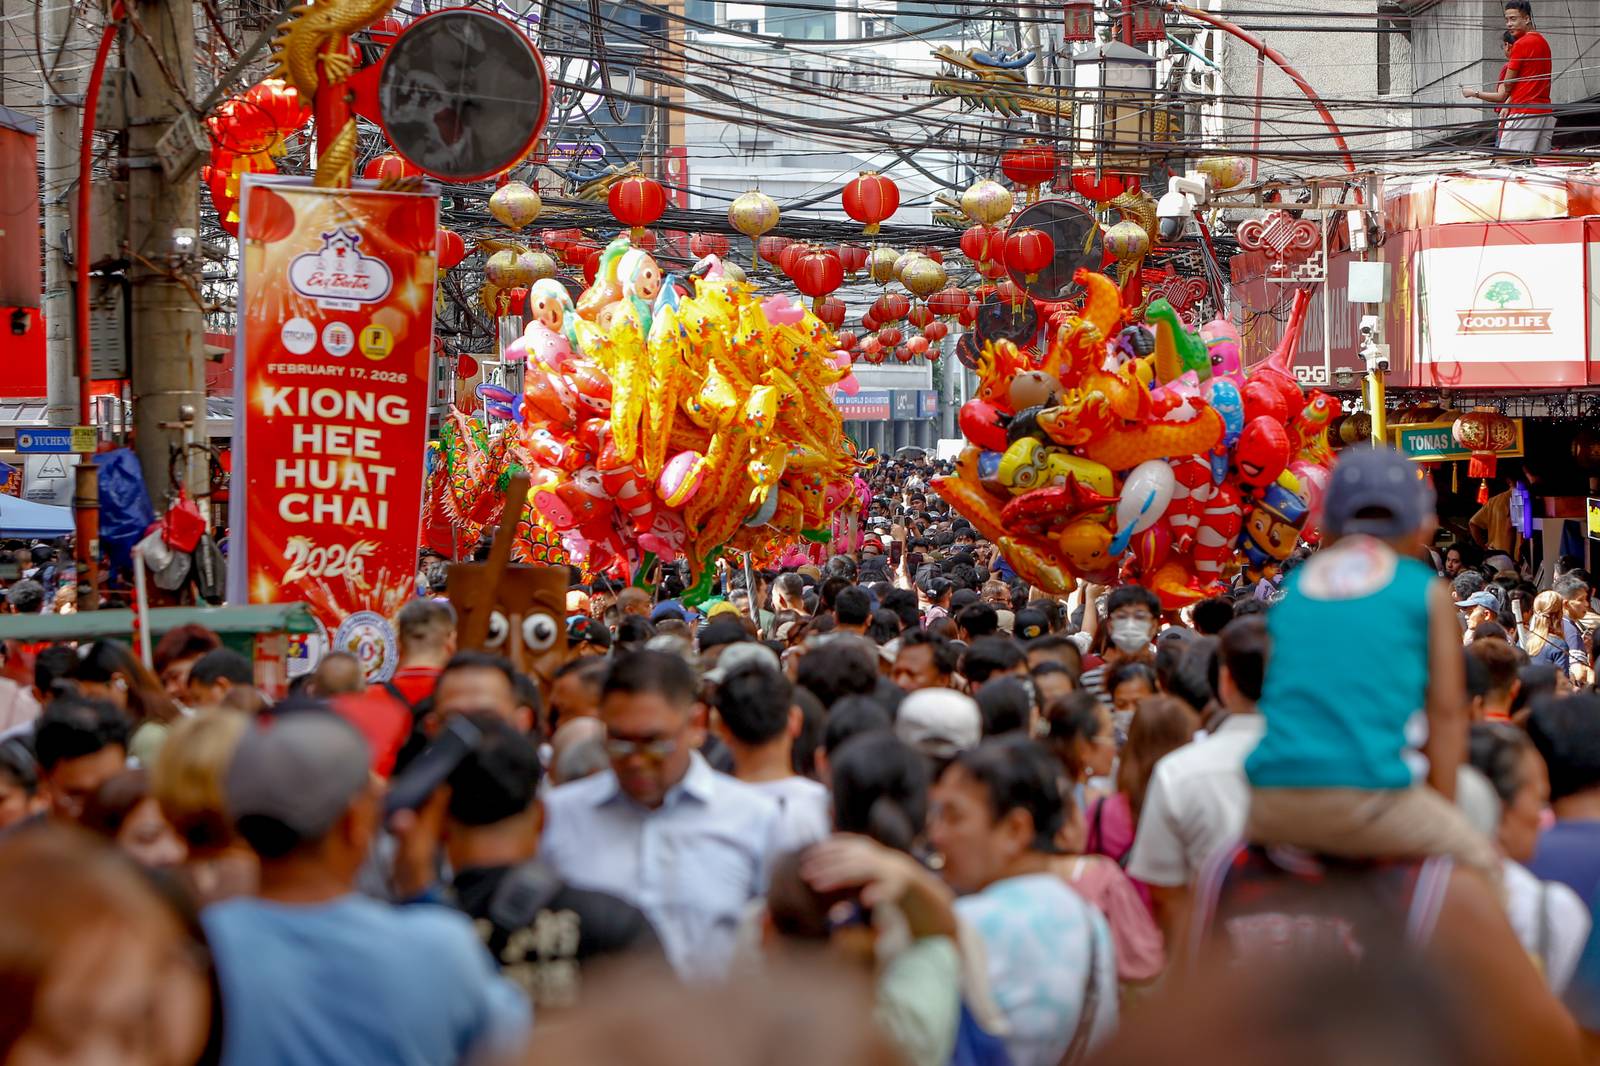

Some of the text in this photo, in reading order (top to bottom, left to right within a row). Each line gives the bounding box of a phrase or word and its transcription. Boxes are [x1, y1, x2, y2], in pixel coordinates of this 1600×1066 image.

[267, 363, 345, 376] FEBRUARY
[370, 370, 408, 384] 2026
[261, 386, 410, 425] KIONG
[293, 423, 381, 460] HEE
[1408, 433, 1448, 451] TOMAS
[275, 458, 396, 495] HUAT
[278, 492, 389, 530] CHAI
[281, 535, 382, 589] 2026
